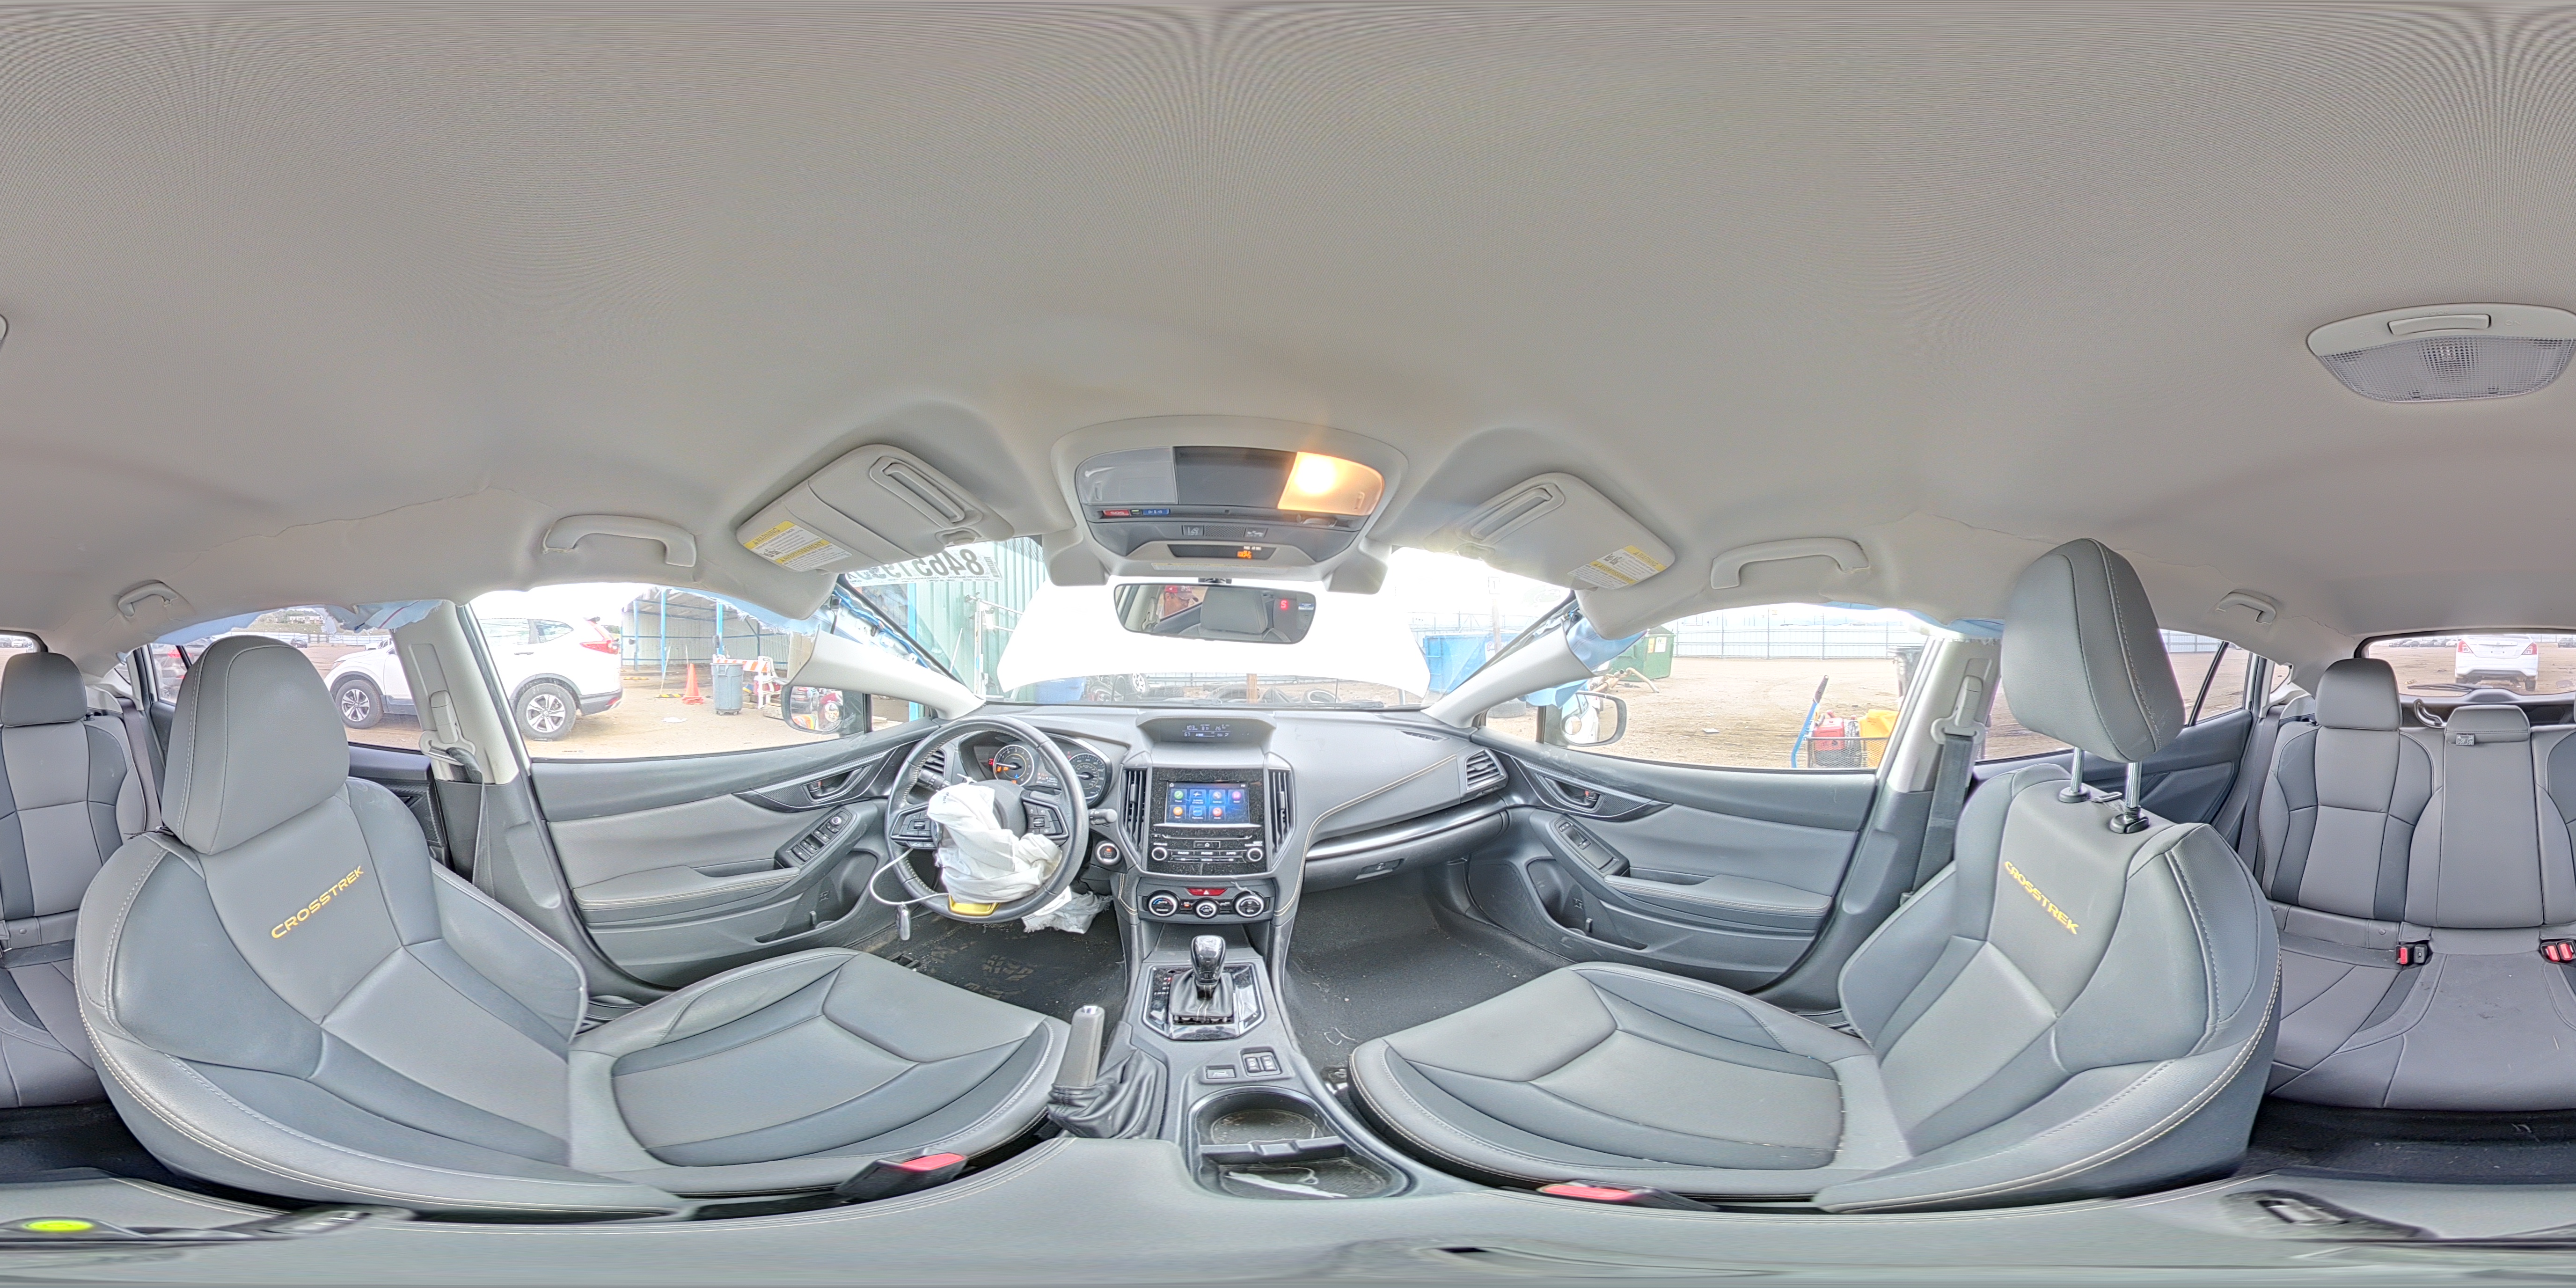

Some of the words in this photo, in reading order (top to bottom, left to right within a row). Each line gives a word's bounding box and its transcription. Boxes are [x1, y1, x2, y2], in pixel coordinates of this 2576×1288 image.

[756, 528, 780, 544] WARNING
[783, 541, 824, 562] AVERTISSEMENT
[1638, 551, 1657, 567] WARNING
[1597, 564, 1633, 582] AVERTISSEMENT
[271, 865, 364, 938] CROSSTREK
[2005, 861, 2079, 935] CROSSTREK
